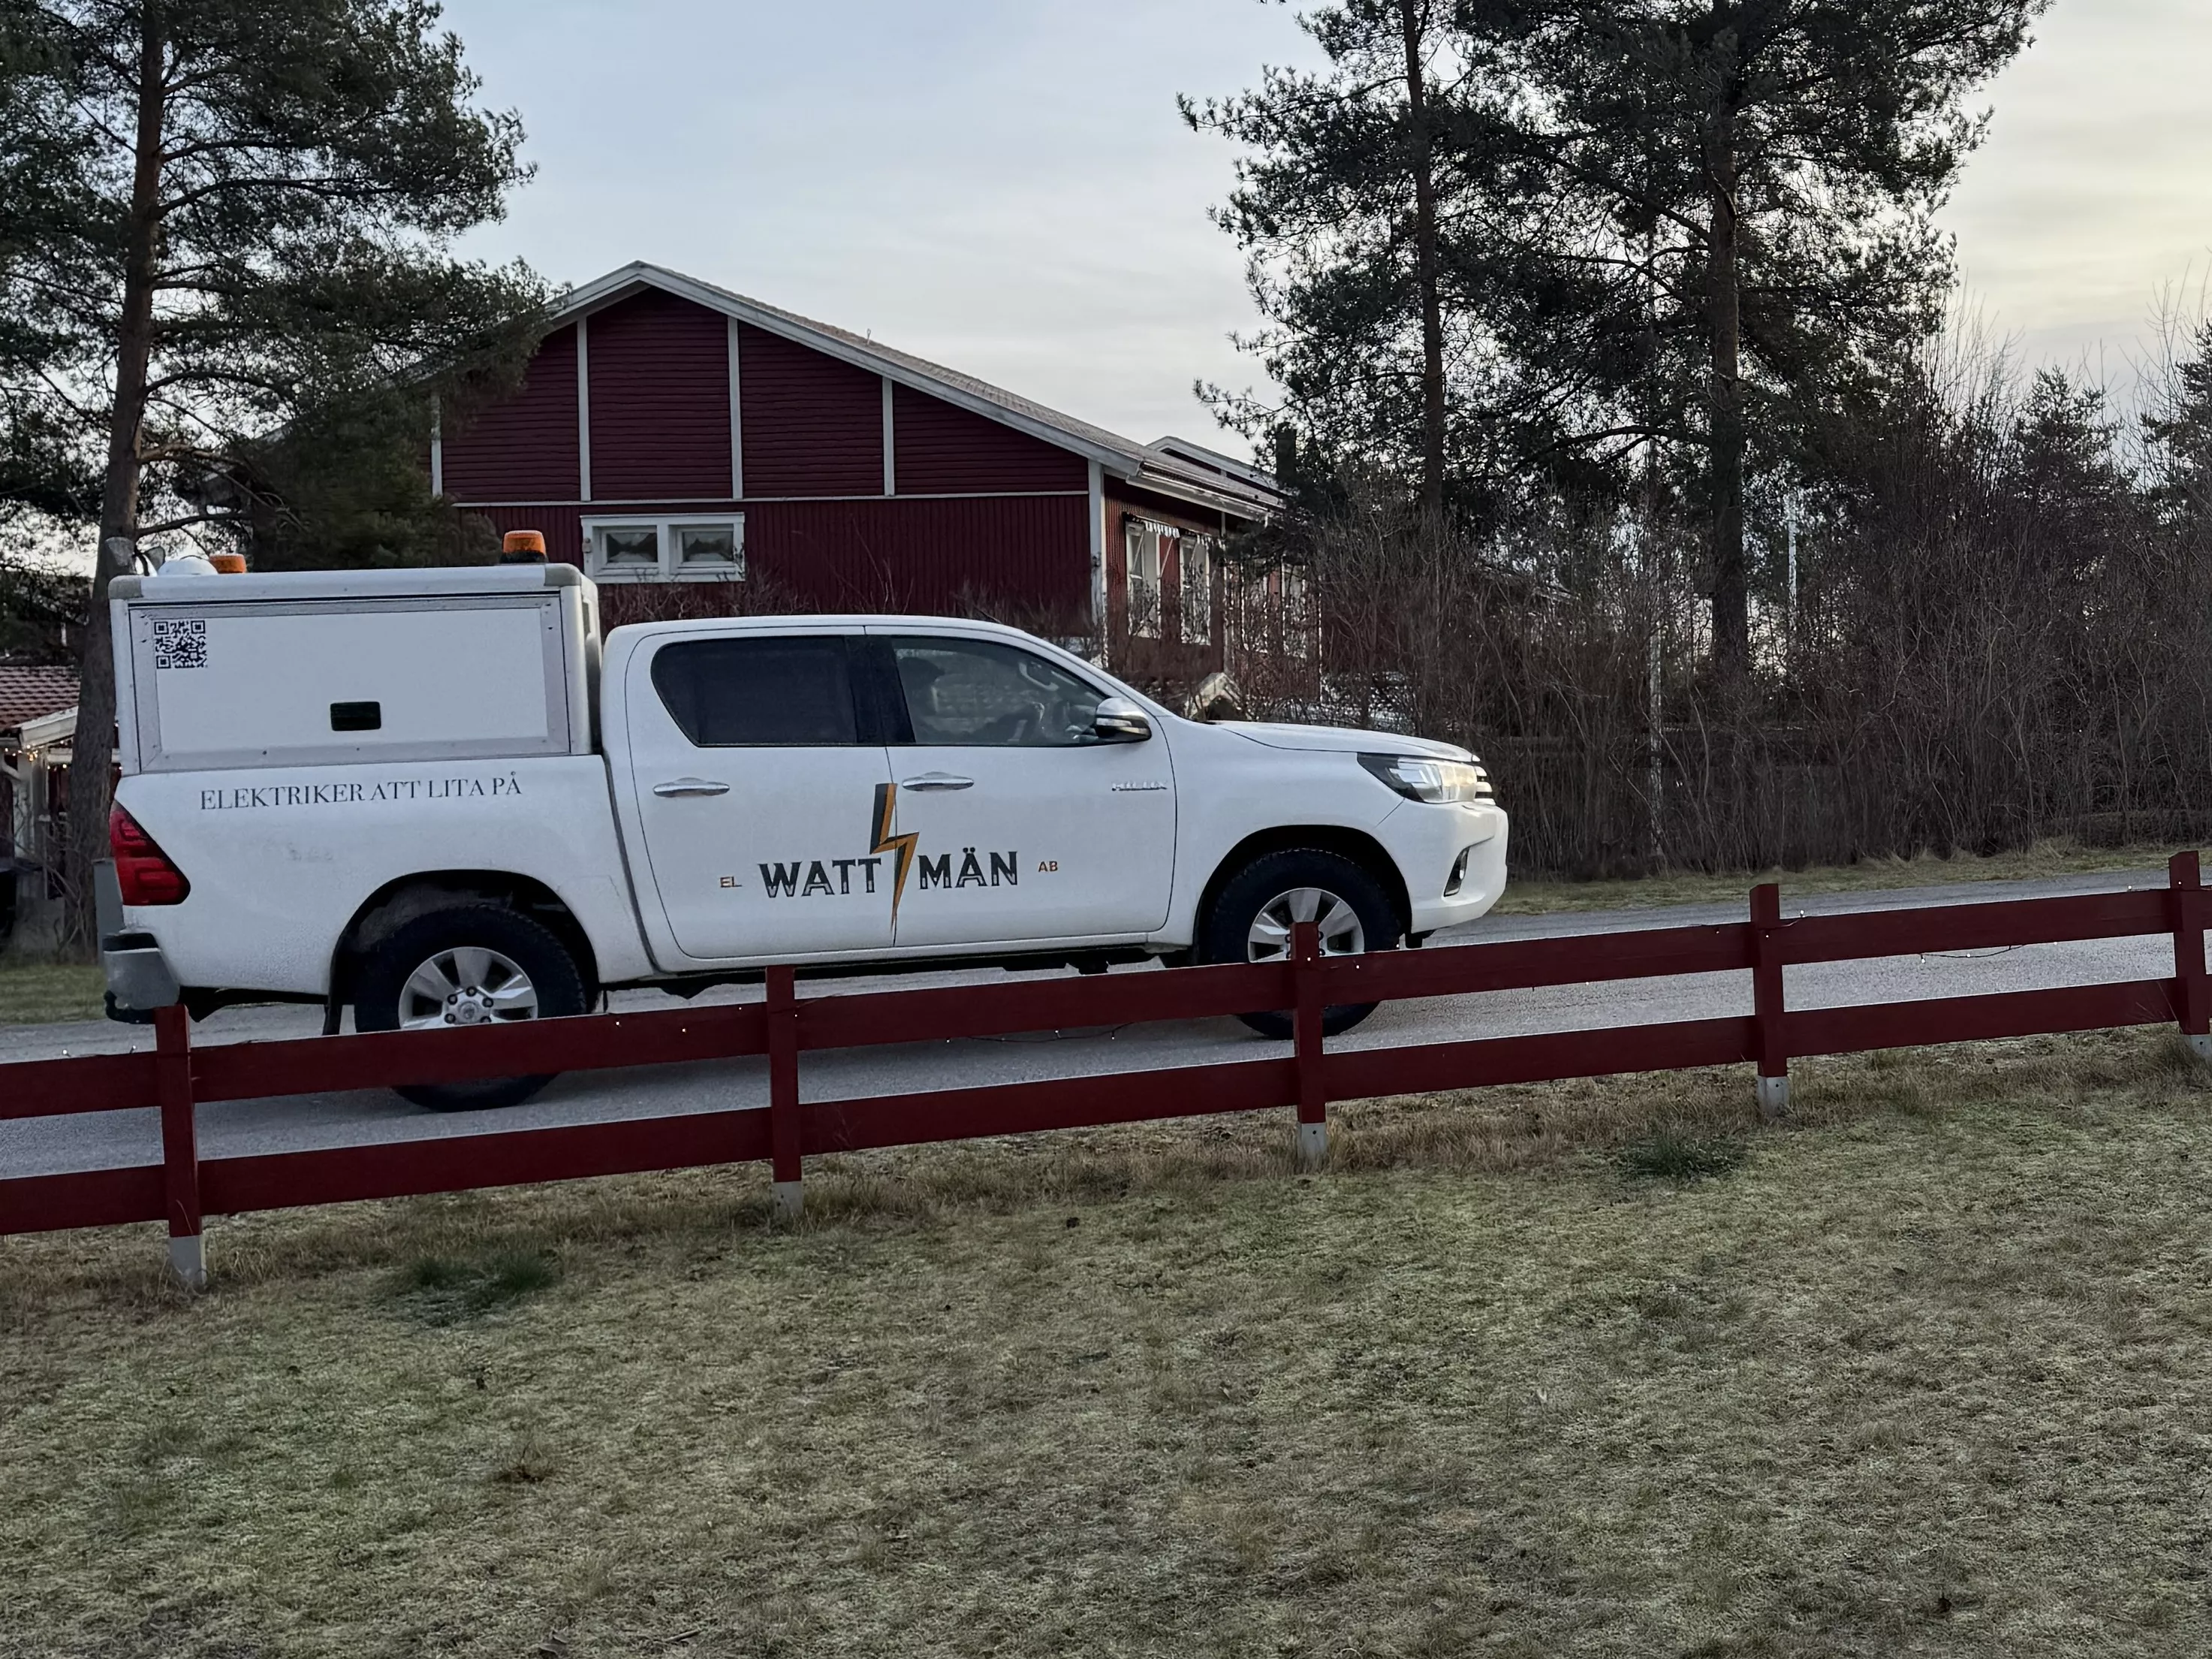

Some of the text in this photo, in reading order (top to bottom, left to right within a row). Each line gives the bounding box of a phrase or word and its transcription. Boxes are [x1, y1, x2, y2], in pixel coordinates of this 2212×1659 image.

[200, 771, 522, 810] ELEKTRIKER ATT LITA PÅ
[719, 846, 1059, 898] EL WATT MÄN AB
